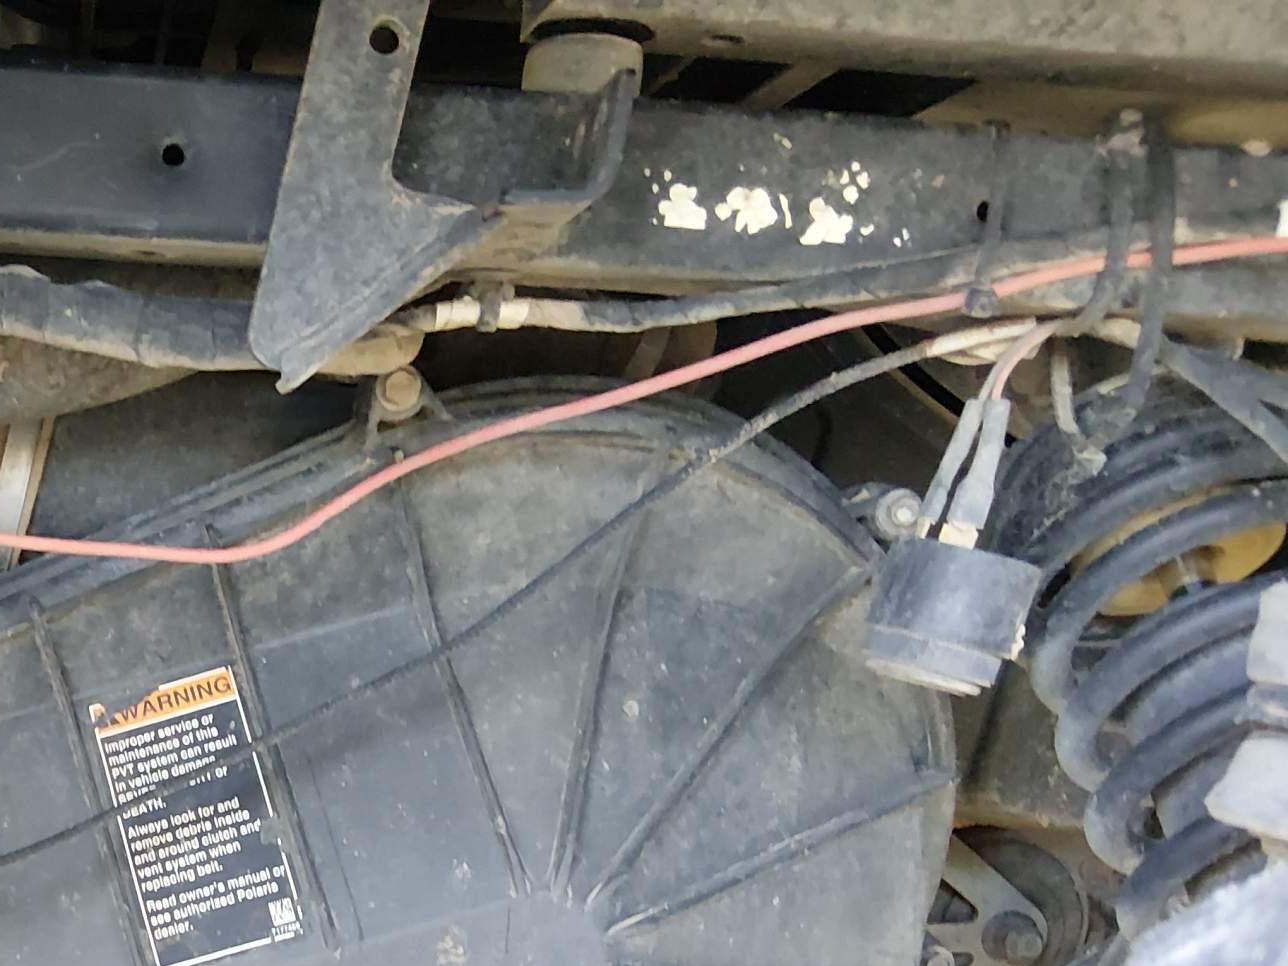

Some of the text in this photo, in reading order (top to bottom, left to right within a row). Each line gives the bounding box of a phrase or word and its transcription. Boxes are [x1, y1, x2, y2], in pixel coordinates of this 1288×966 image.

[121, 676, 231, 720] WARNING
[105, 713, 214, 754] Improper service or
[108, 726, 219, 766] maintenance of this
[112, 734, 238, 779] PVT system can result
[128, 767, 169, 788] vehicle
[215, 766, 229, 779] or
[128, 796, 240, 840] Always look for and
[131, 809, 251, 852] remove debris inside
[134, 818, 261, 866] and around clutch and
[137, 841, 241, 879] vent system when
[141, 863, 223, 893] replacing belt.
[146, 864, 285, 913] Read owner's manual or
[150, 881, 279, 927] see authorized Polaris
[154, 921, 194, 940] dealer.
